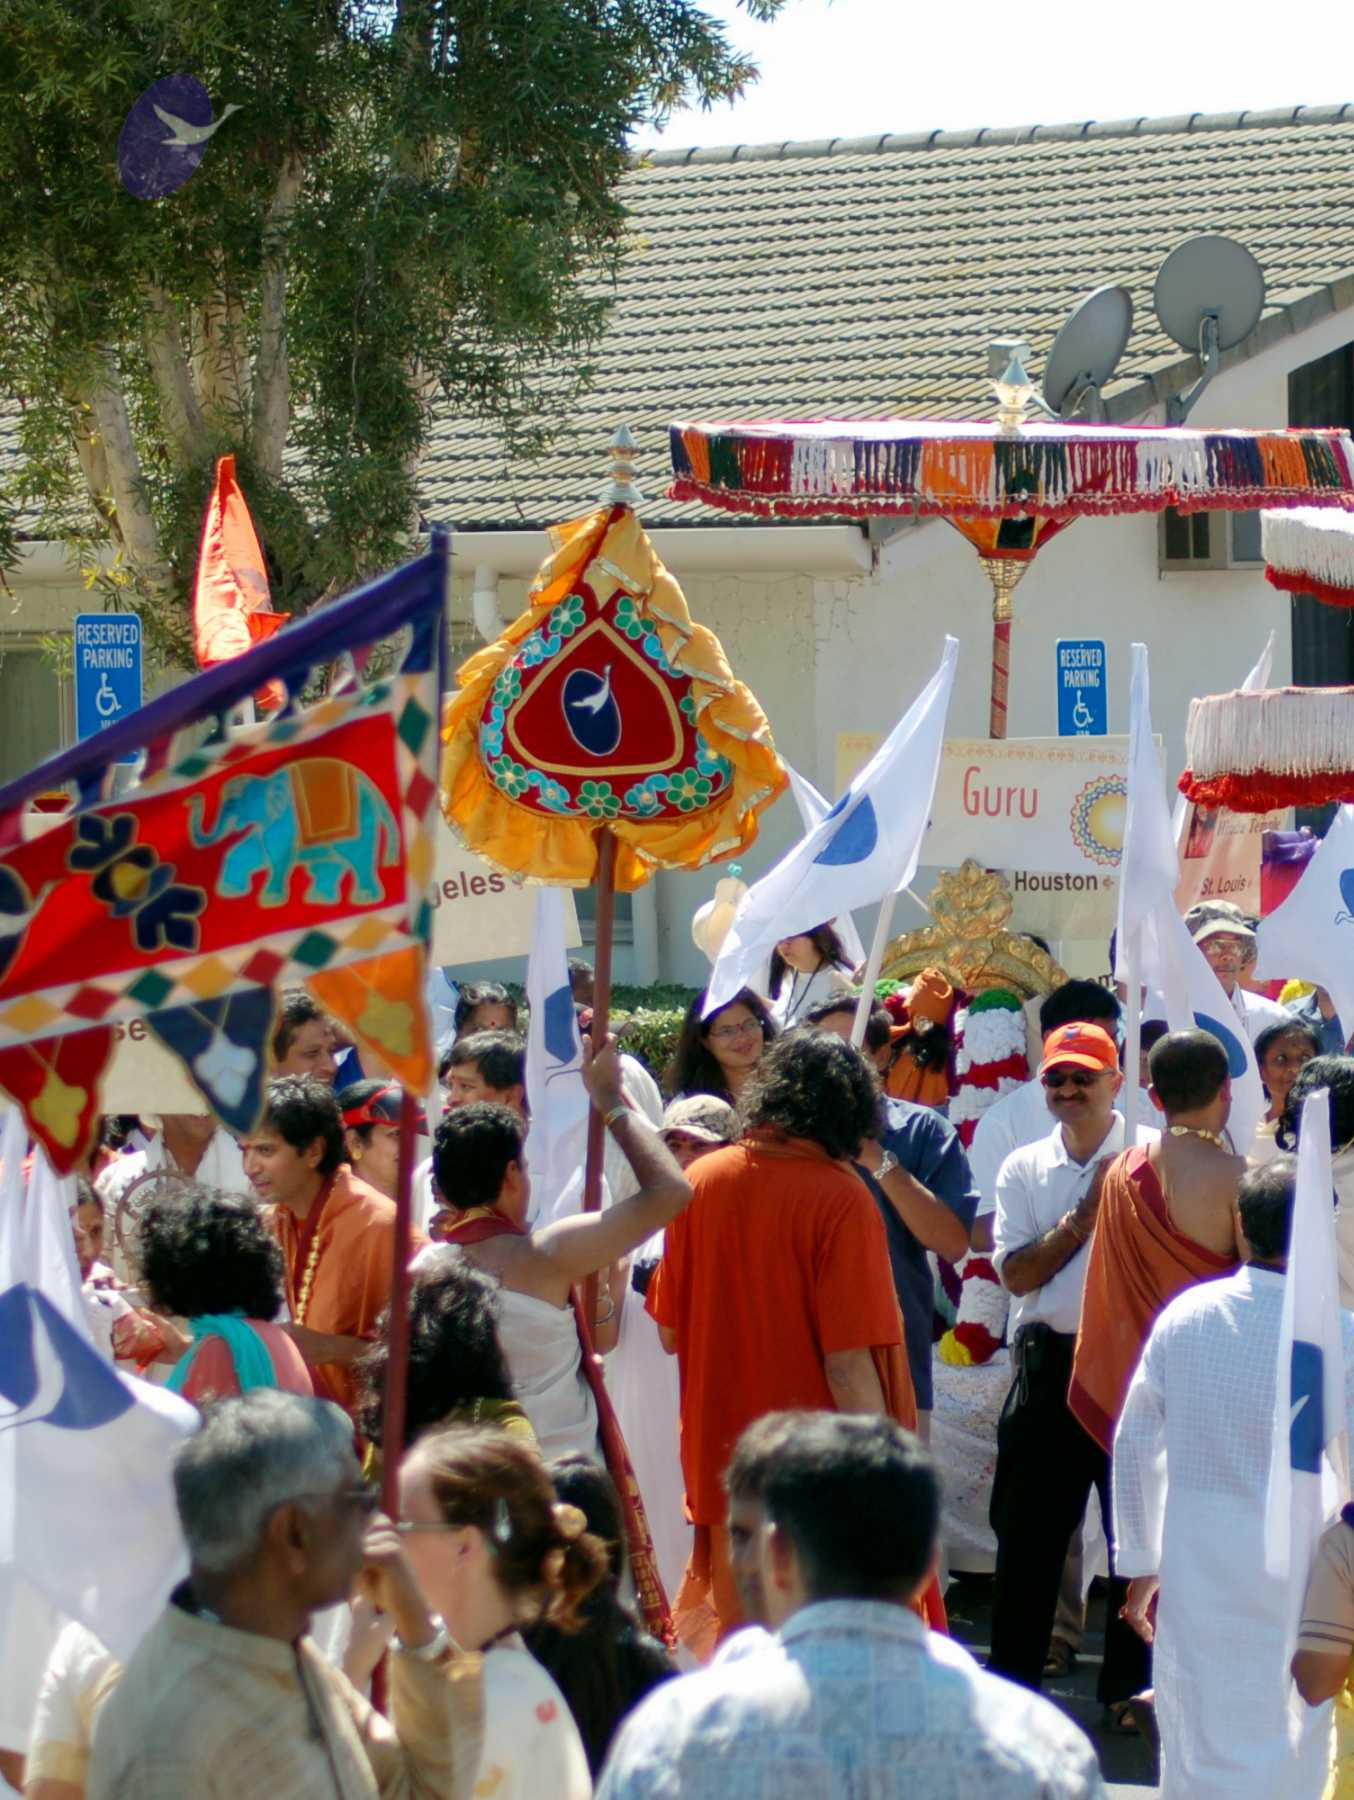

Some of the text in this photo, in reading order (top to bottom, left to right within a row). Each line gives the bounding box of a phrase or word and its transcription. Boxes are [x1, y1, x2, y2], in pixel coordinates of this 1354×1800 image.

[77, 623, 138, 644] RESERVED
[83, 647, 133, 669] PARKING
[1060, 648, 1102, 667] RESERVED
[1064, 670, 1100, 688] PARKING
[963, 766, 1038, 818] Guru
[1014, 872, 1098, 891] Houston
[1217, 875, 1246, 893] Louis
